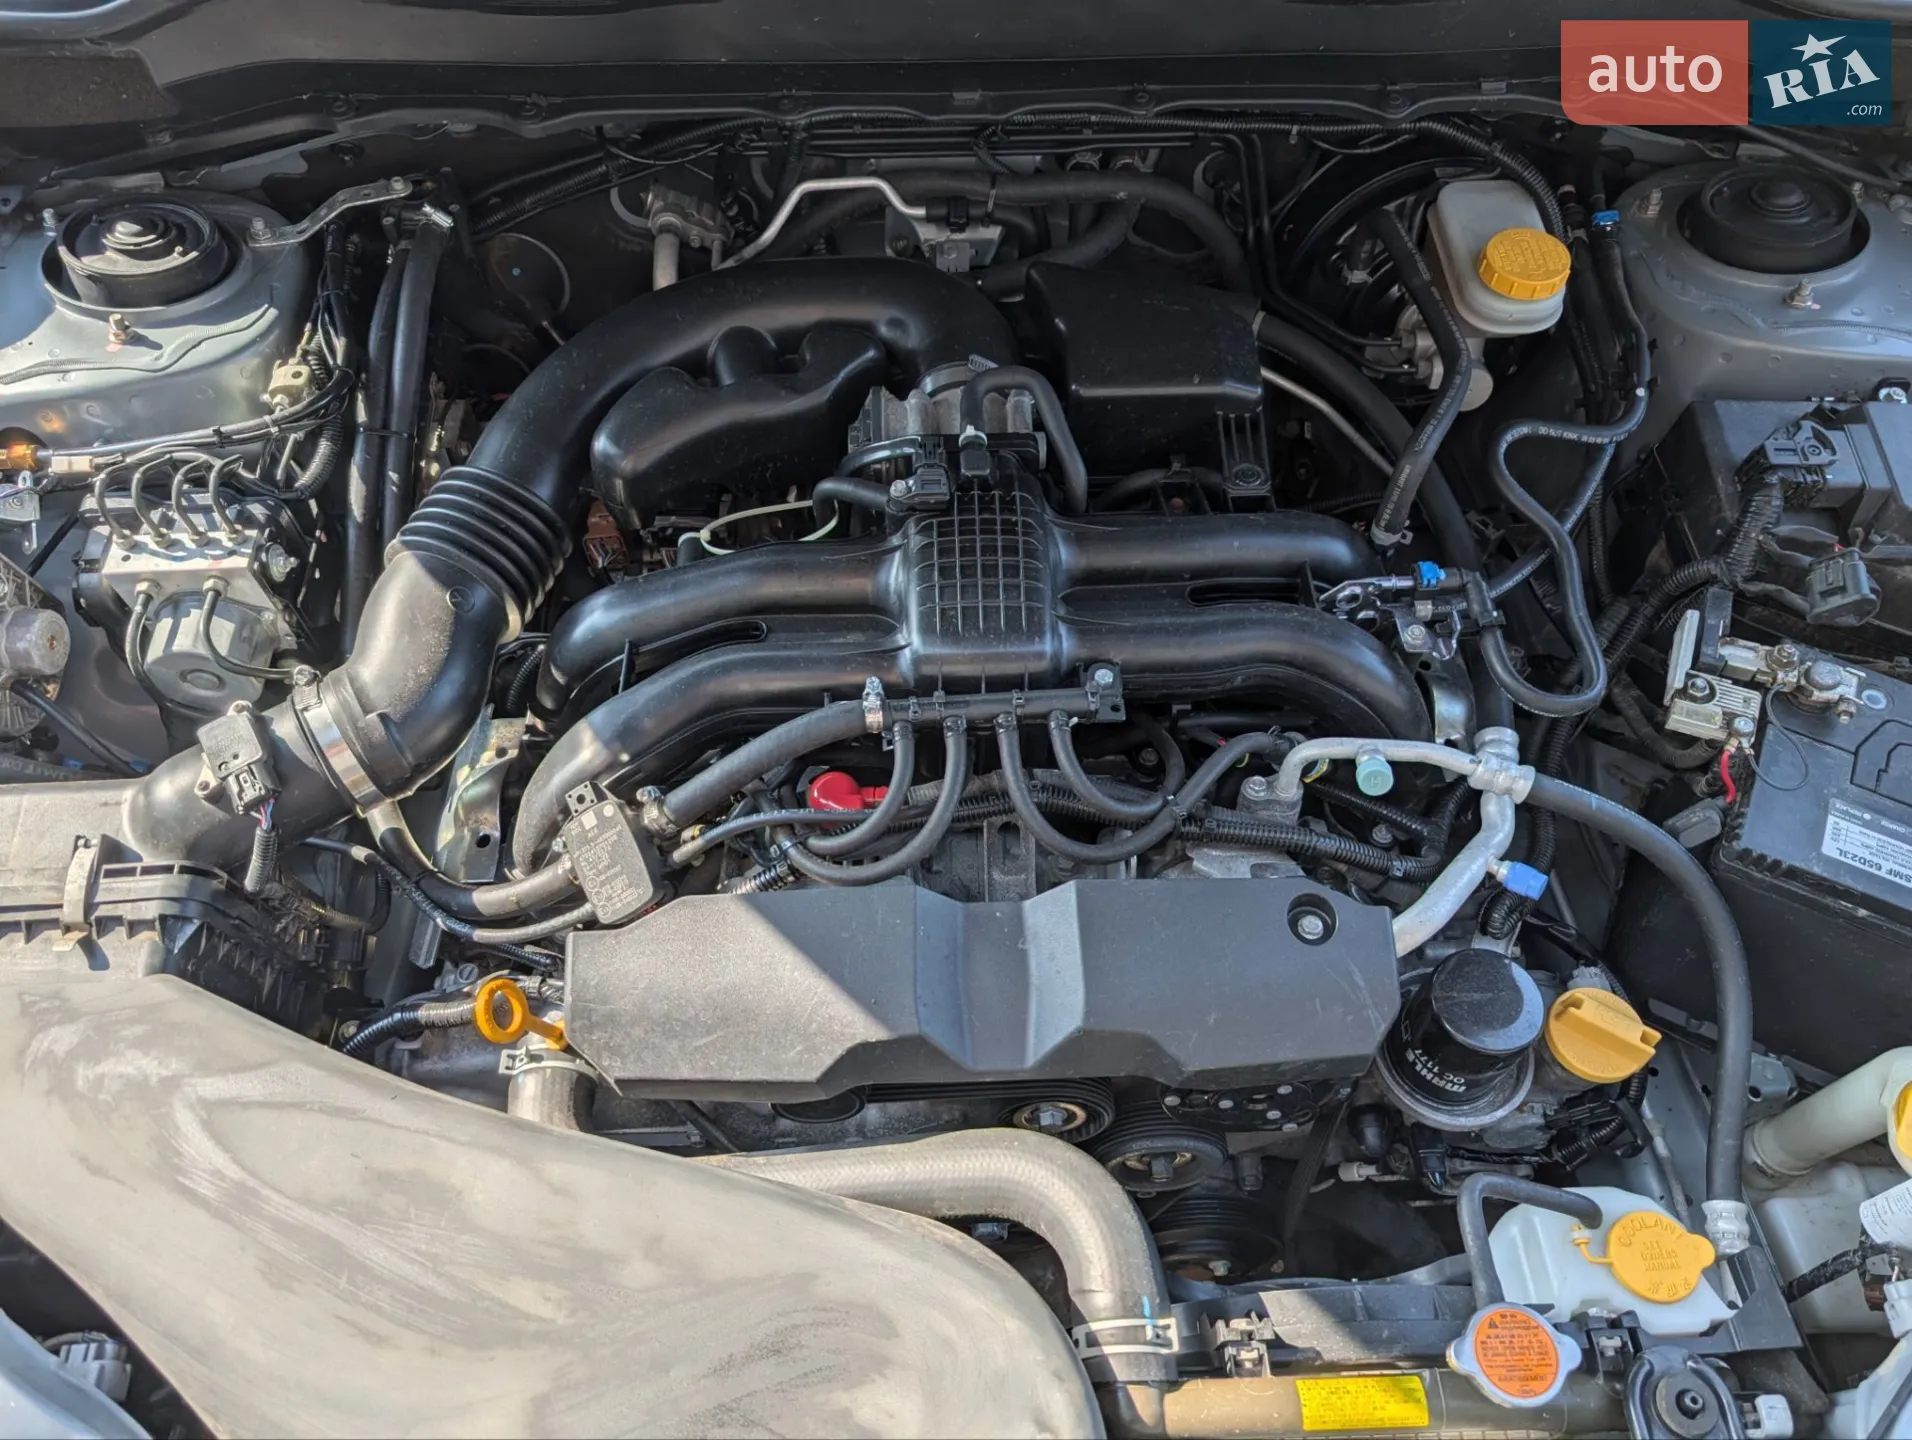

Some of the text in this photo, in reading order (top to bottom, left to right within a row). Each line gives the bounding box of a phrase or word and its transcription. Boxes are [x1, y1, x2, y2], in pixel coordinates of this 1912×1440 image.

[1836, 847, 1912, 884] SMF 65D23L
[1405, 1048, 1467, 1093] MAHLE
[1414, 1049, 1465, 1084] OC 1177
[1618, 1216, 1684, 1247] COOLANT
